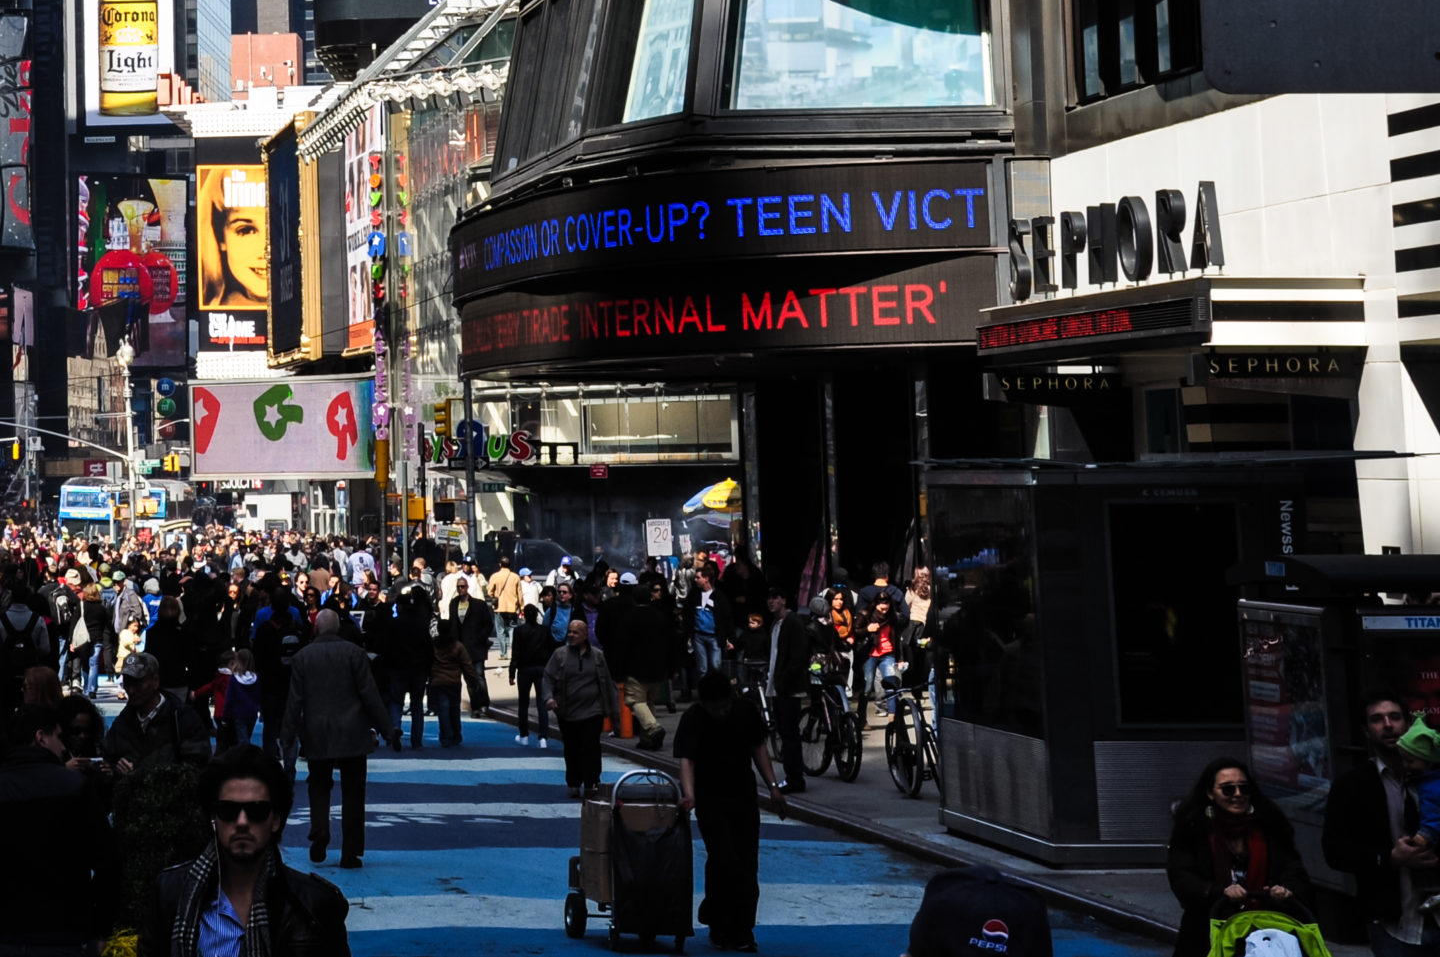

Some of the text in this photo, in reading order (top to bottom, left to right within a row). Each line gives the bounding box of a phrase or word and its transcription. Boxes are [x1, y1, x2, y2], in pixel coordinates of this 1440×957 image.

[102, 7, 155, 27] Corona
[107, 49, 152, 73] Light
[483, 223, 538, 271] COMPASSION
[541, 218, 560, 257] OR
[564, 199, 711, 253] COVER-UP?
[726, 193, 852, 238] TEEN
[871, 187, 985, 232] VICT
[1007, 180, 1225, 302] SEPHORA
[742, 280, 947, 331] MATTER'
[1210, 356, 1341, 374] SEPHORA
[1001, 376, 1110, 391] SEPHORA
[969, 937, 1008, 953] PEPSI
